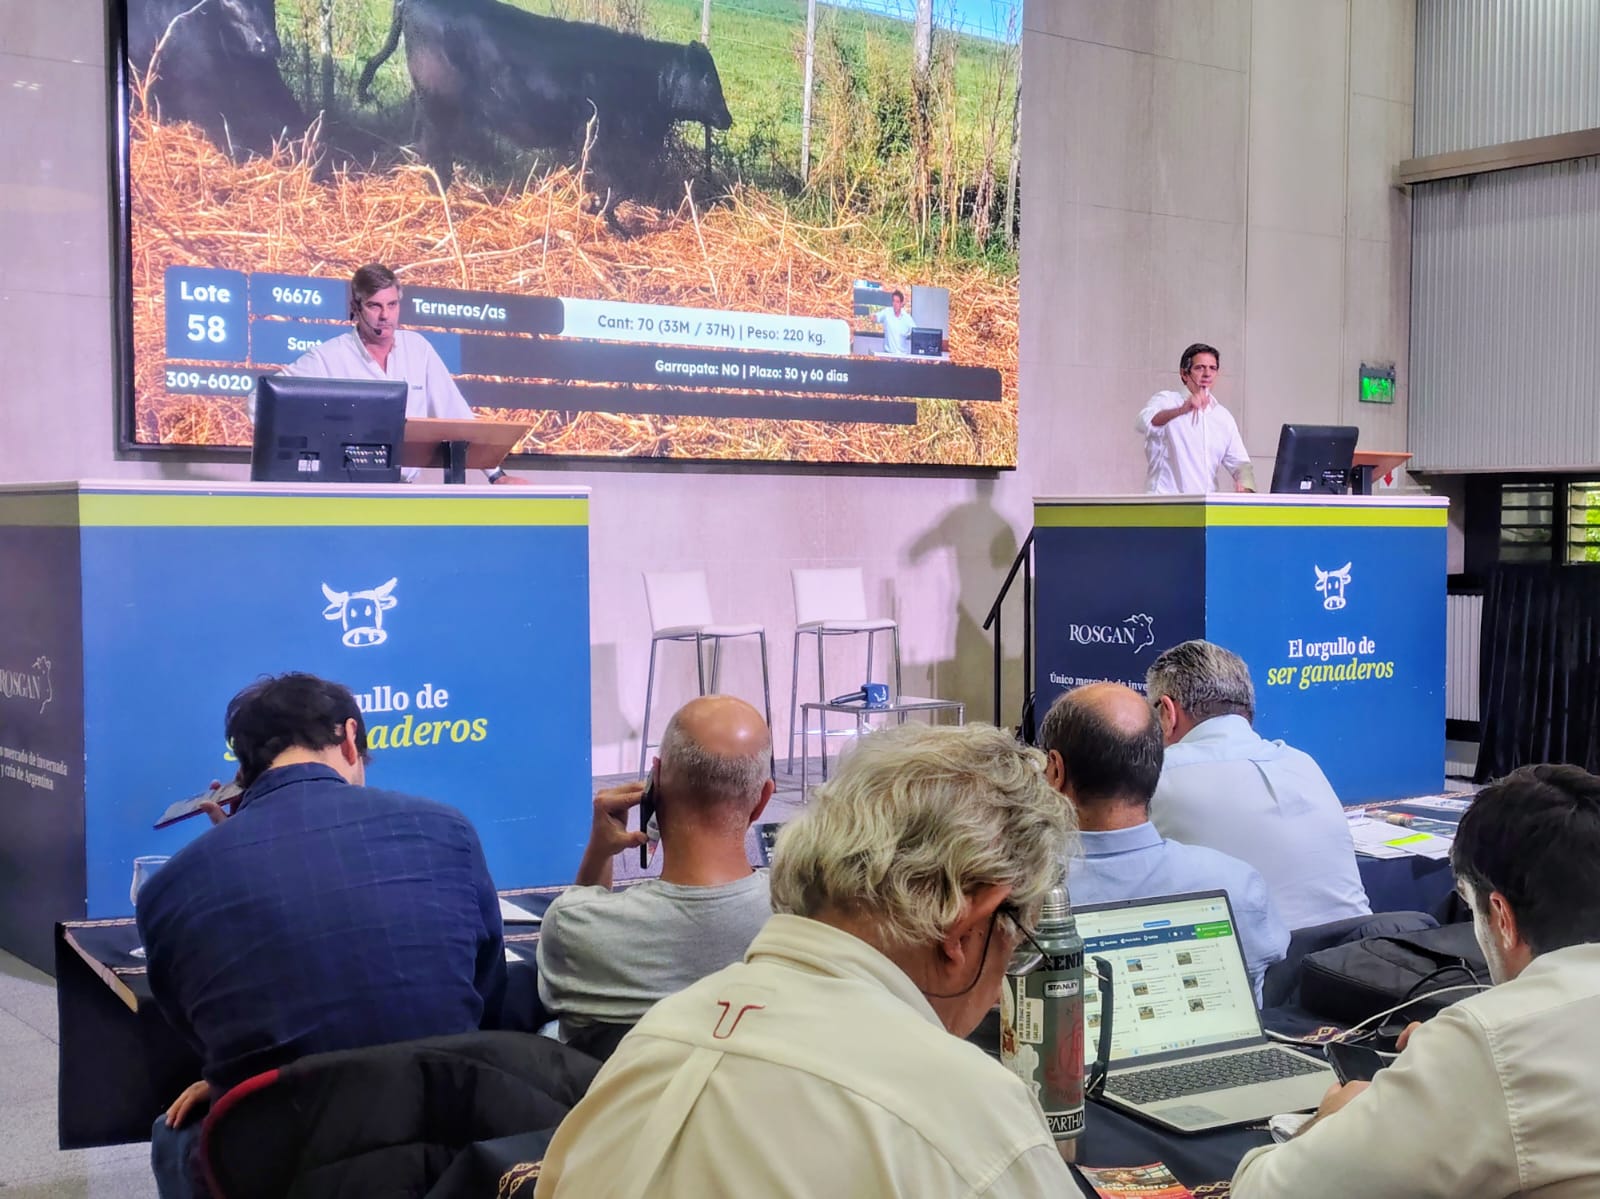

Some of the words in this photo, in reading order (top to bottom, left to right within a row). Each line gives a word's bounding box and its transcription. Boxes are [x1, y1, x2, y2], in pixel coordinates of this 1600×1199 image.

[180, 281, 231, 303] Lote
[272, 286, 322, 305] 96676
[412, 298, 507, 320] Terneros/as
[187, 314, 226, 343] 58
[597, 314, 633, 331] Cant:
[637, 317, 654, 332] 70
[658, 319, 690, 336] (33M
[706, 322, 736, 340] 37H)
[747, 325, 780, 341] Peso:
[783, 328, 804, 342] 220
[807, 330, 827, 346] kg.
[165, 371, 252, 391] 309-6020
[655, 358, 718, 378] Garrapata:
[721, 363, 740, 377] NO
[749, 364, 782, 379] Plazo:
[784, 366, 799, 381] 30
[801, 371, 807, 383] y
[810, 367, 824, 382] 60
[1069, 623, 1136, 647] ROSGAN
[1288, 640, 1303, 658] El
[1305, 638, 1355, 661] orgullo
[1359, 636, 1376, 655] de
[1049, 671, 1074, 684] Único
[1267, 667, 1297, 685] ser
[1299, 657, 1394, 689] ganaderos
[351, 686, 409, 713] ullo
[416, 683, 449, 709] de
[366, 715, 488, 750] aderos
[1048, 982, 1078, 992] STANLEY
